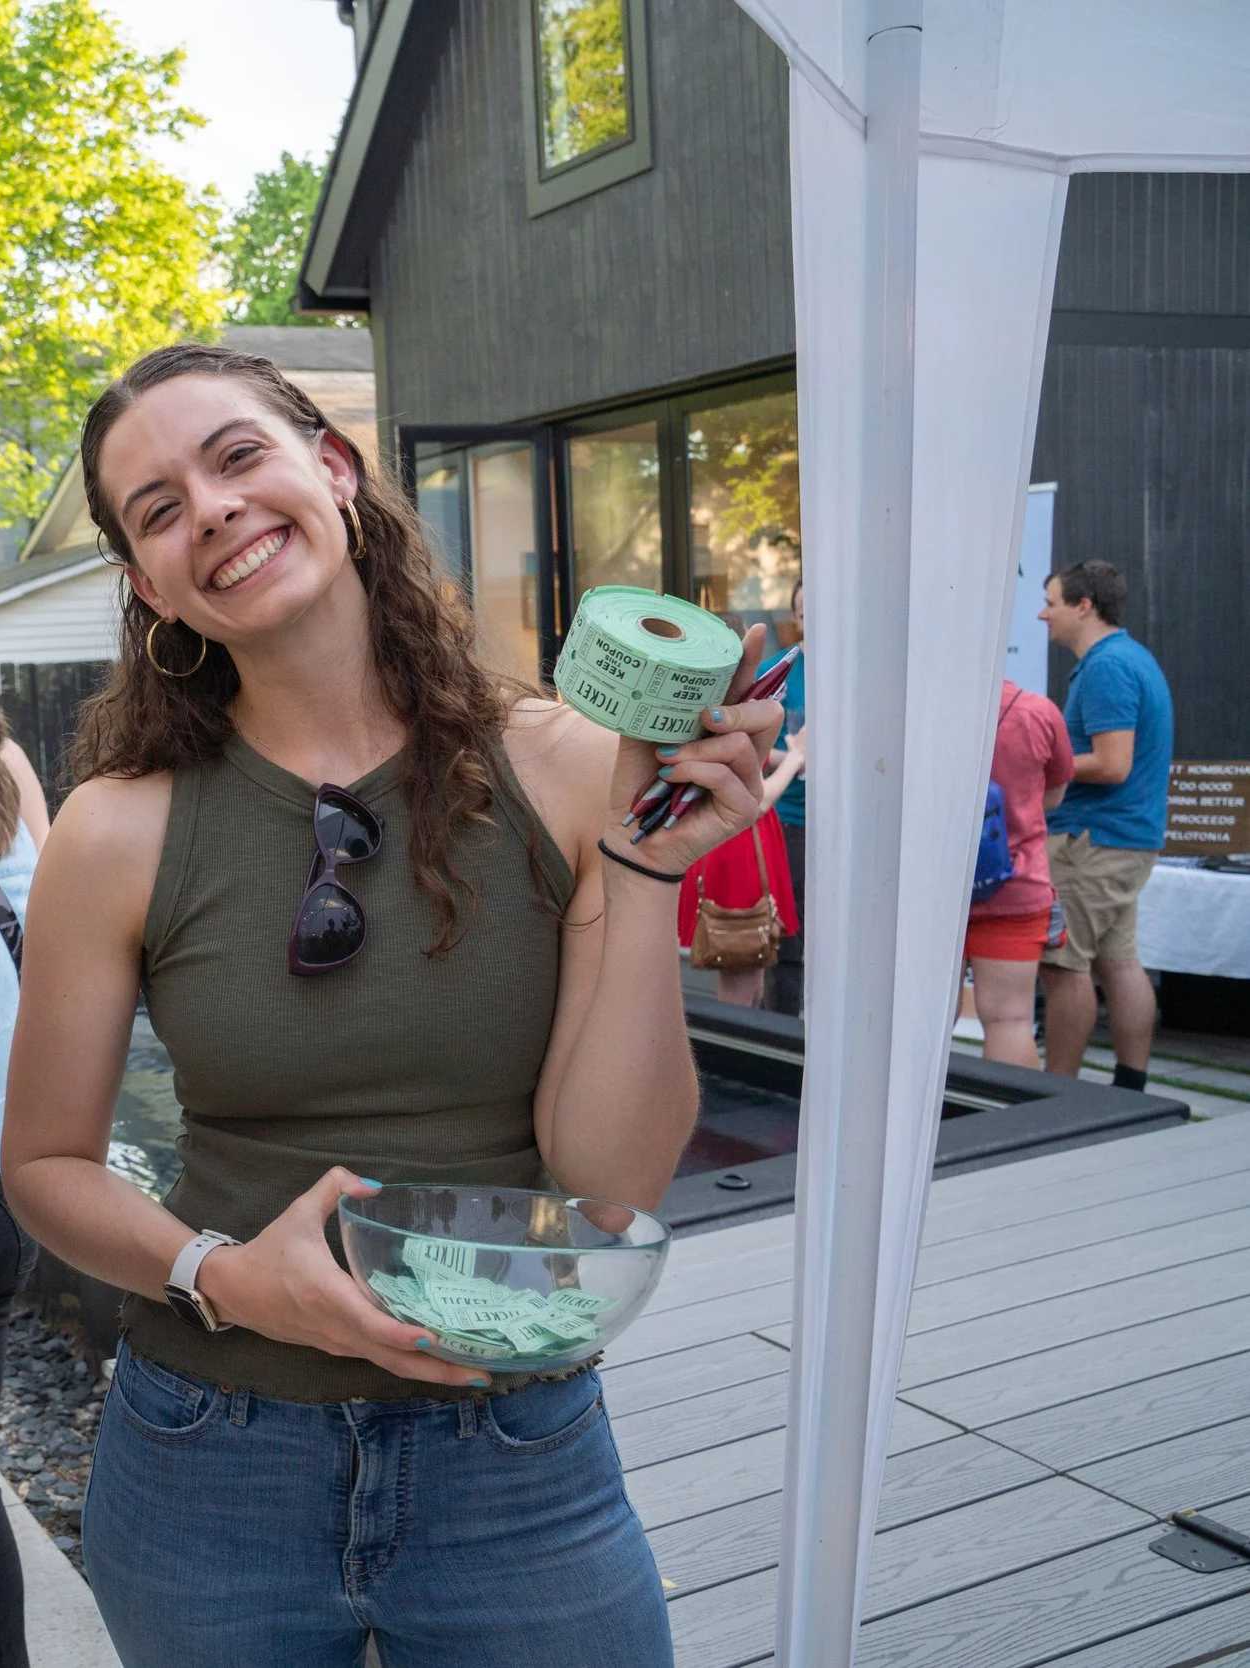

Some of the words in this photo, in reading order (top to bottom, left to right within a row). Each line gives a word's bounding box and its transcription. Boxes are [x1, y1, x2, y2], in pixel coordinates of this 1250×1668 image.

[596, 637, 641, 669] COUPON
[605, 654, 622, 668] THIS
[596, 659, 626, 680] KEEP
[671, 673, 716, 686] COUPON
[576, 680, 619, 716] TICKET
[673, 690, 703, 700] KEEP
[649, 714, 695, 733] TICKET
[1198, 781, 1234, 792] GOOD
[1200, 797, 1245, 808] BETTER
[1171, 814, 1236, 826] PROCEEDS
[557, 1294, 600, 1309] TICKET
